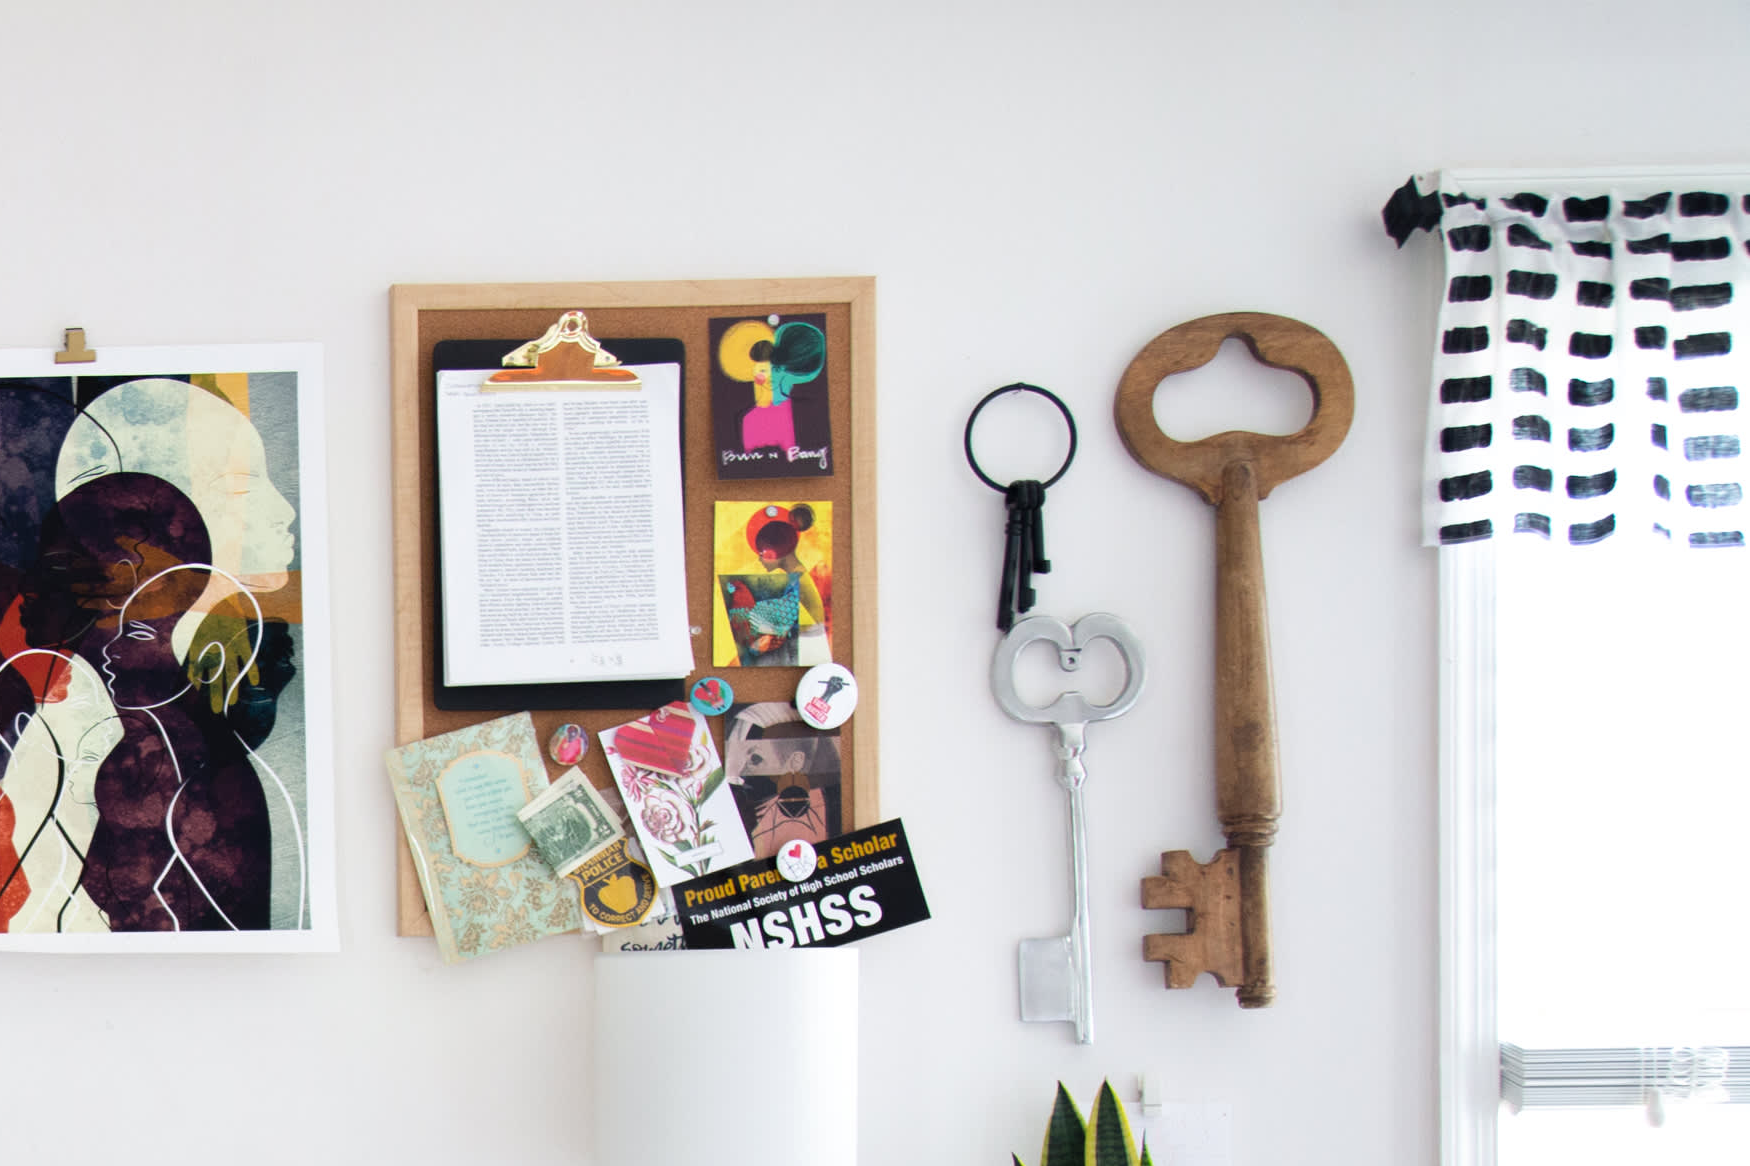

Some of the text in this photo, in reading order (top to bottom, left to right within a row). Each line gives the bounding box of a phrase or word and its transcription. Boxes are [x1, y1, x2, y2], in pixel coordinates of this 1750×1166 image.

[722, 450, 764, 466] Bun
[787, 446, 828, 469] Bang
[582, 854, 624, 881] POLICE
[684, 832, 898, 908] Proud Paren a Scholar
[588, 902, 600, 915] TO
[599, 911, 638, 924] CORRECT
[690, 856, 904, 926] The National Society of High School Scholars
[729, 885, 883, 949] NSHSS
